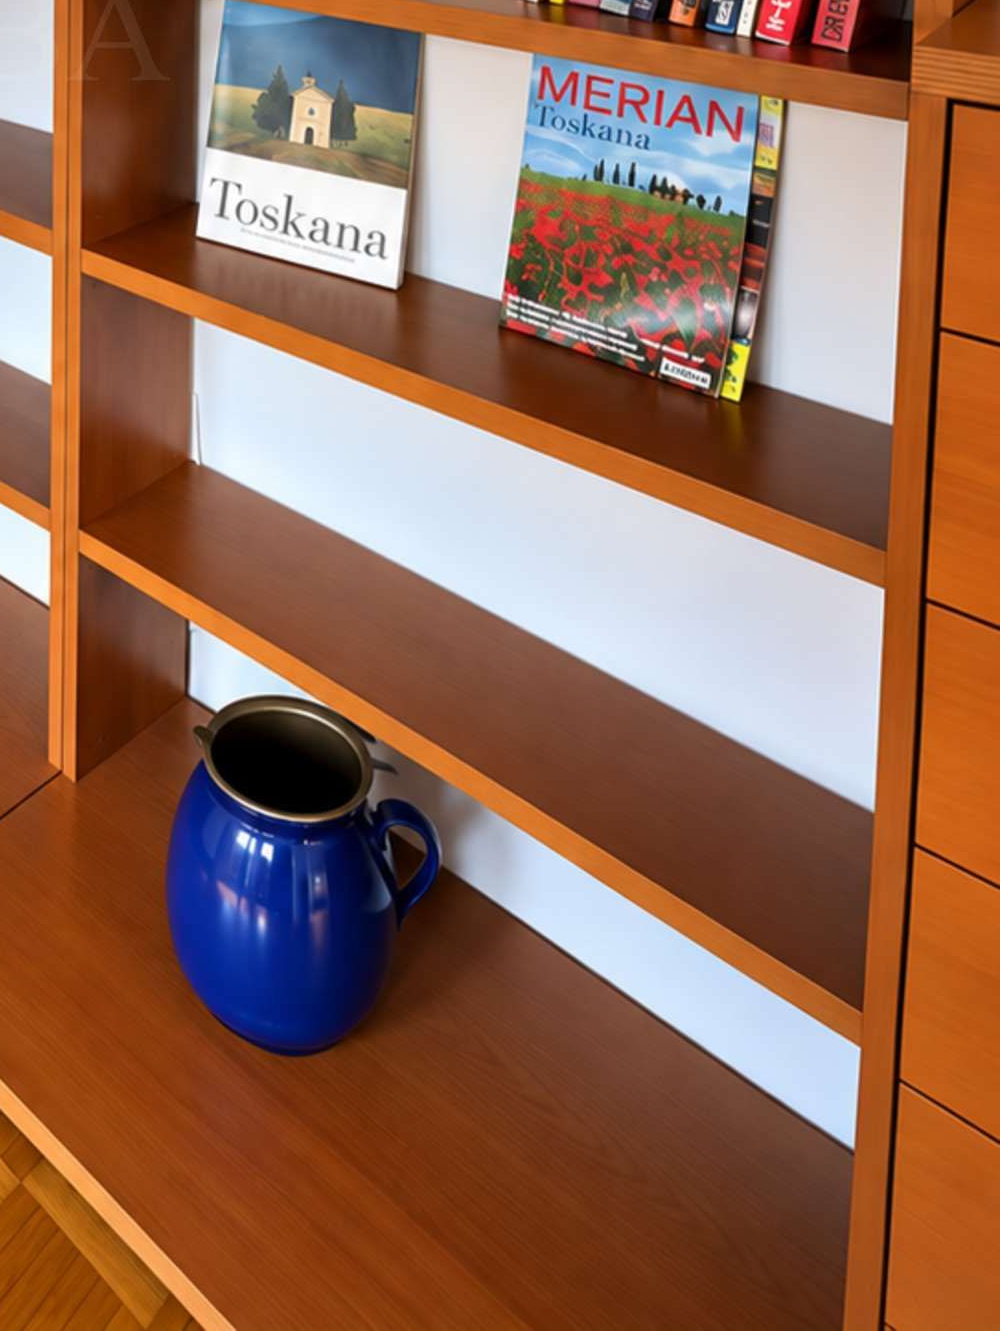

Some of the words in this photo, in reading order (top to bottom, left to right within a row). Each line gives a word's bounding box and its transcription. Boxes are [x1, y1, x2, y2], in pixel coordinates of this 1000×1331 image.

[534, 102, 651, 151] Toskana
[536, 65, 745, 143] MERIAN
[209, 177, 389, 260] Toskana
